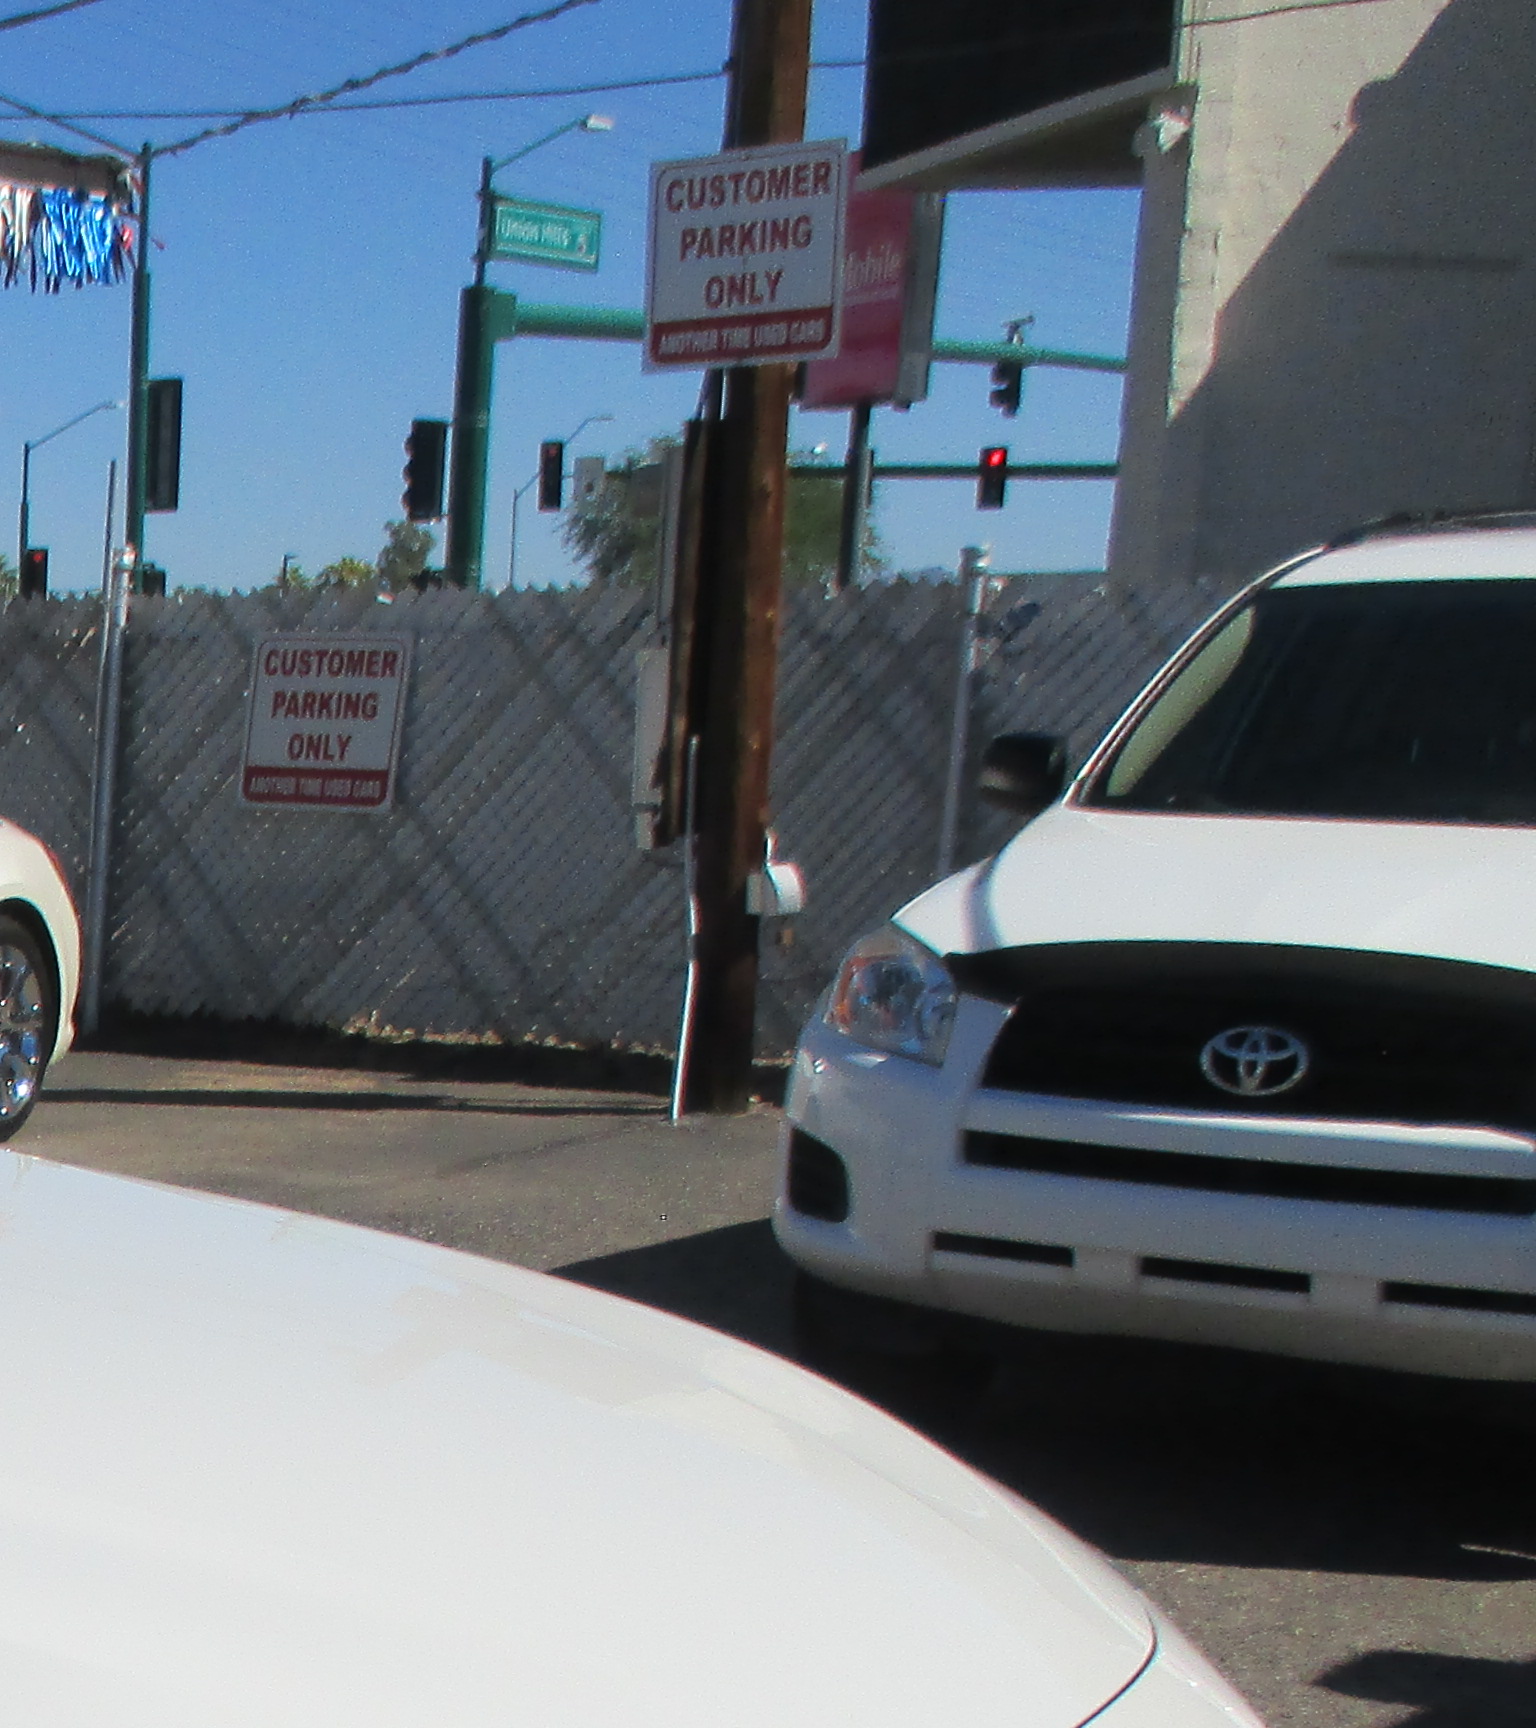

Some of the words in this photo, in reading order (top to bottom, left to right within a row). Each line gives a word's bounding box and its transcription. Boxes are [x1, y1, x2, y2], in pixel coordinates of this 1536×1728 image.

[665, 162, 832, 213] CUSTOMER
[679, 215, 813, 261] PARKING
[704, 269, 784, 309] ONLY
[264, 648, 399, 678] CUSTOMER
[271, 690, 379, 722] PARKING
[288, 733, 352, 762] ONLY
